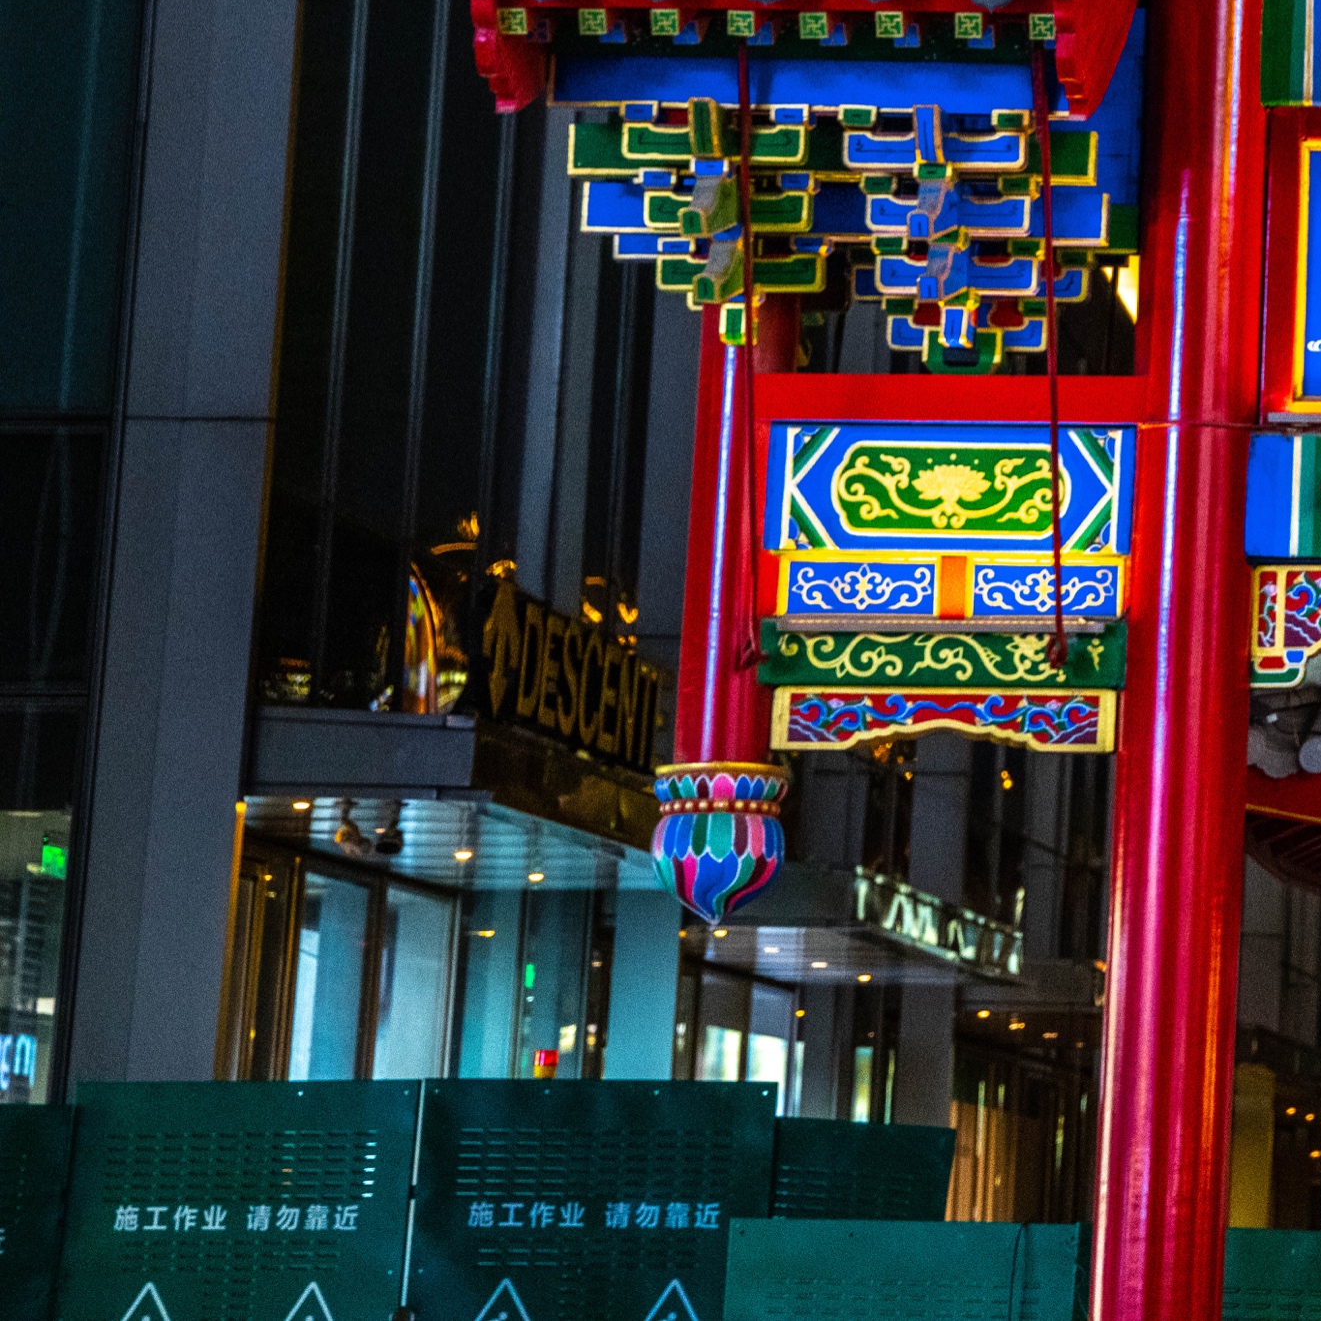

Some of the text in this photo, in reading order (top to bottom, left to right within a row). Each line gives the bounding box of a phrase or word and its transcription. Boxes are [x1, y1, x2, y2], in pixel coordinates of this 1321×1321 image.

[114, 1205, 359, 1231] 施工作业 请勿靠近
[467, 1201, 720, 1229] 施工作业 请勿靠近
